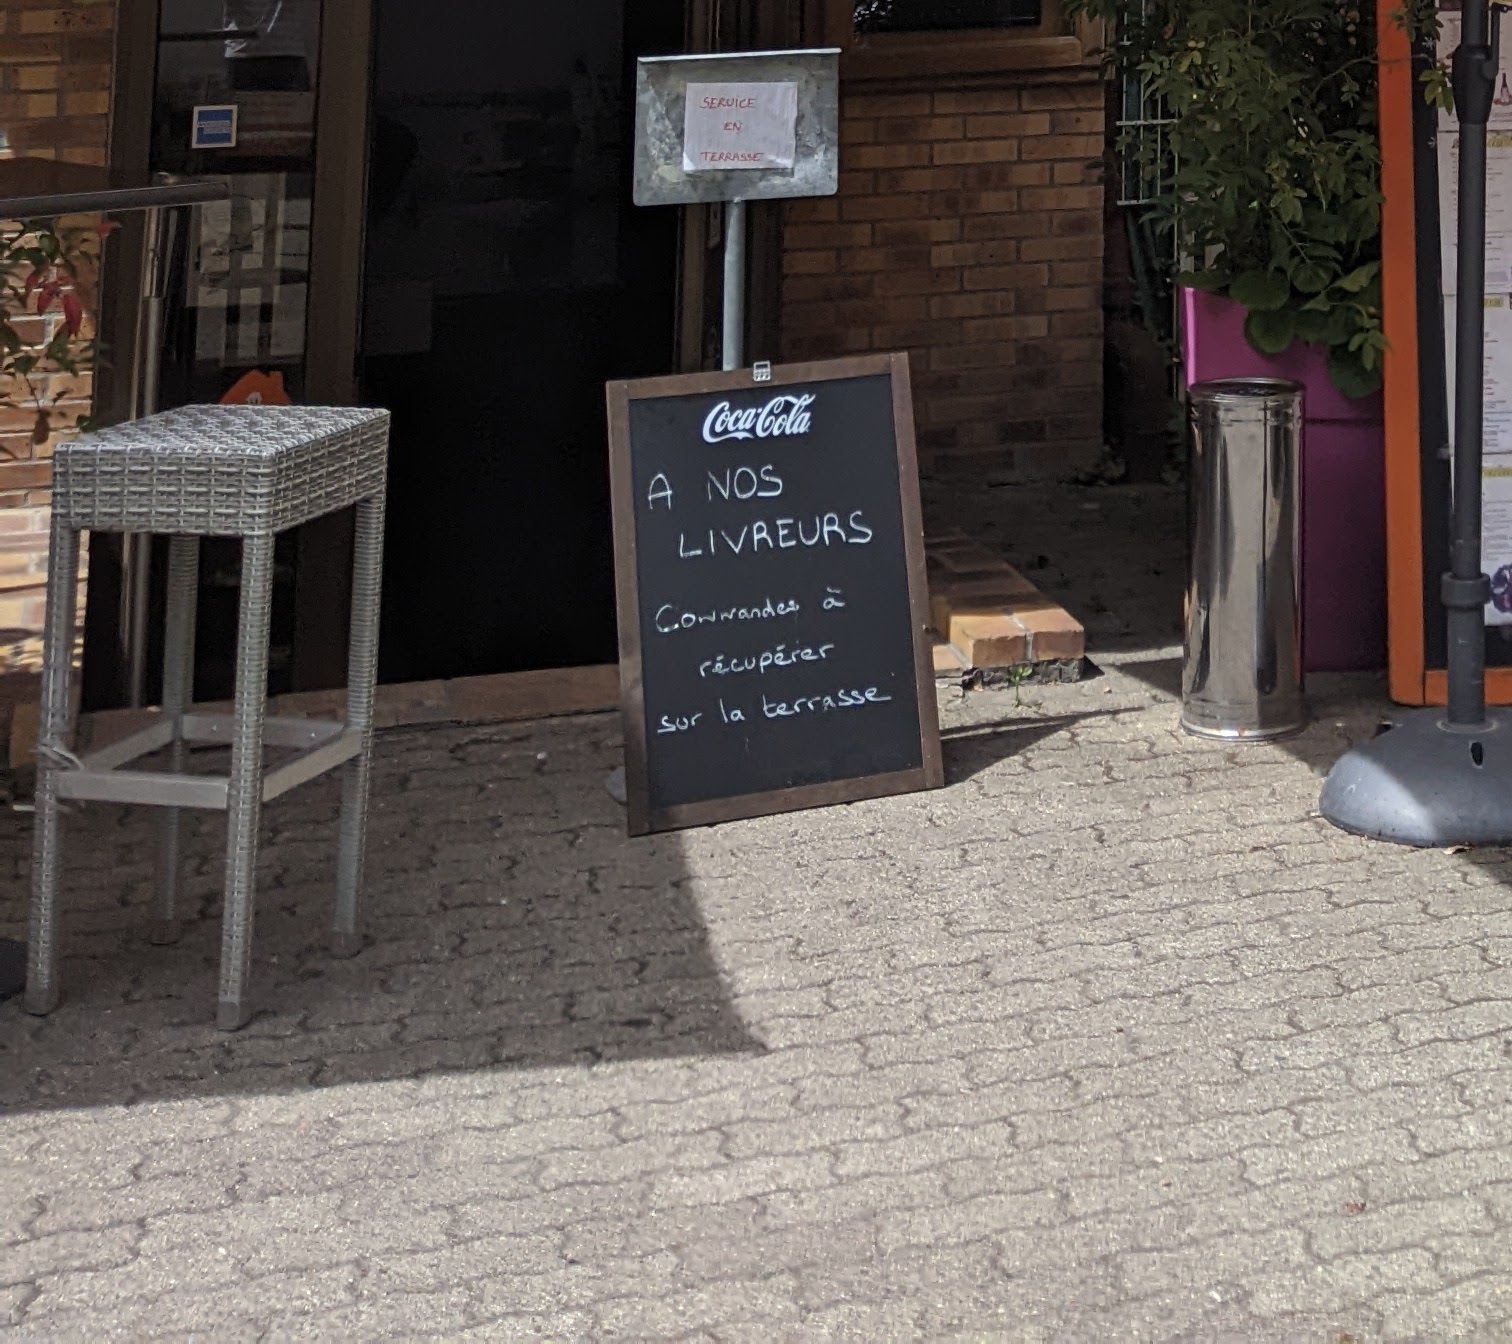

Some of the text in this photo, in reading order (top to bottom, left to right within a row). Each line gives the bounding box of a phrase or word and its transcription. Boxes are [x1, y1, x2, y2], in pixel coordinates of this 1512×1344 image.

[699, 96, 756, 109] SERVICE
[723, 121, 743, 132] EN
[700, 151, 764, 162] TERRASSE
[702, 393, 816, 443] Coca-Cola
[647, 464, 783, 510] A NOS
[678, 510, 873, 559] LIVREURS
[655, 586, 846, 633] Commandes à
[699, 643, 835, 680] récupérer
[657, 686, 892, 733] sur la terrasse
